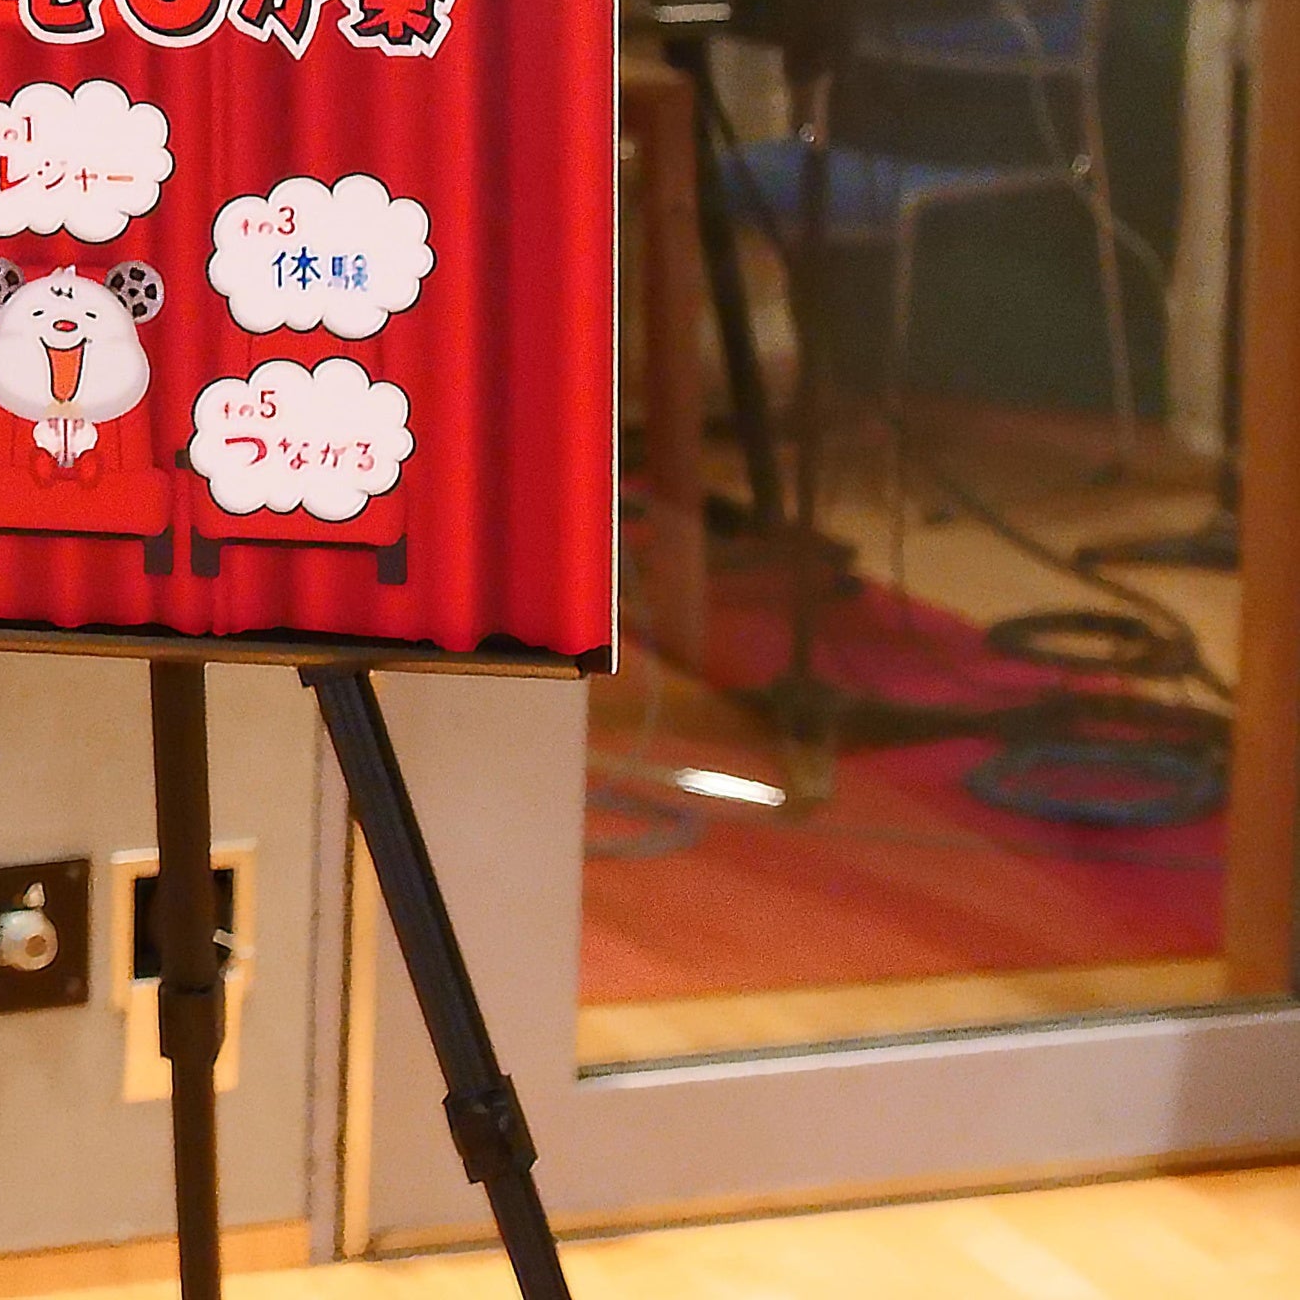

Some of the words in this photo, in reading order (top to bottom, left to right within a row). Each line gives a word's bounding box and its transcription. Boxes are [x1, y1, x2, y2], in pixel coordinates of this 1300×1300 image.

[0, 155, 135, 193] レジャー
[272, 246, 369, 292] 体験
